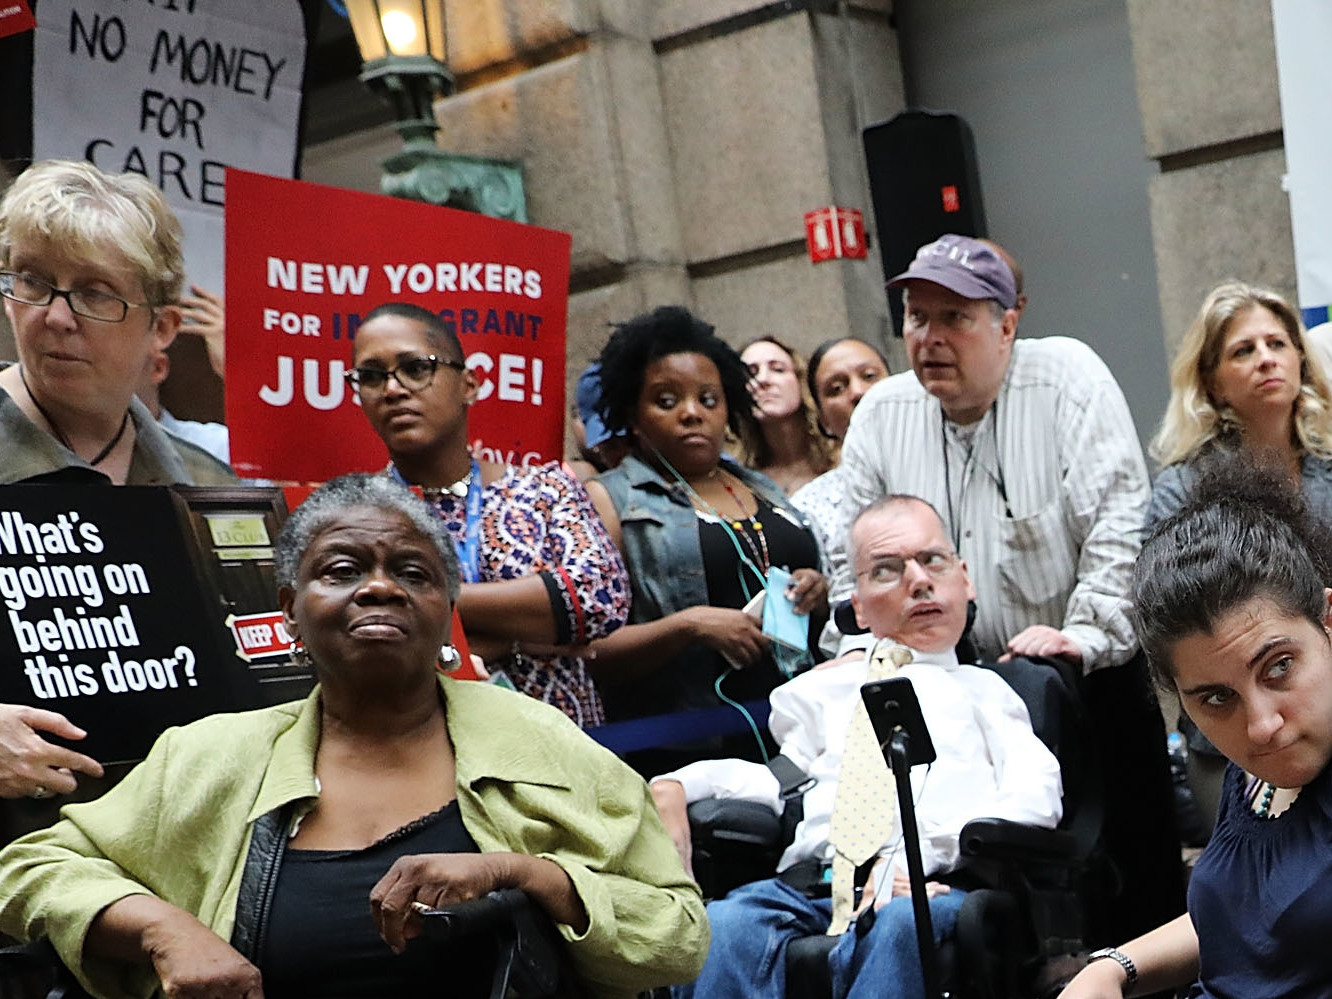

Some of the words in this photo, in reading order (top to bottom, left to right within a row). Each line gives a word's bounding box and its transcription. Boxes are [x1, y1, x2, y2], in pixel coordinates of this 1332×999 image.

[70, 8, 126, 62] NO
[151, 29, 287, 100] MONEY
[140, 88, 205, 150] FOR
[267, 256, 369, 296] NEW
[383, 262, 543, 299] YORKERS
[263, 308, 321, 337] FOR
[332, 308, 543, 341] IGRANT
[258, 351, 544, 411] JUCE!
[0, 555, 104, 610] going
[103, 563, 150, 595] on
[8, 604, 140, 653] behind
[238, 623, 274, 649] KEEP
[24, 654, 99, 699] this
[101, 645, 198, 693] door?
